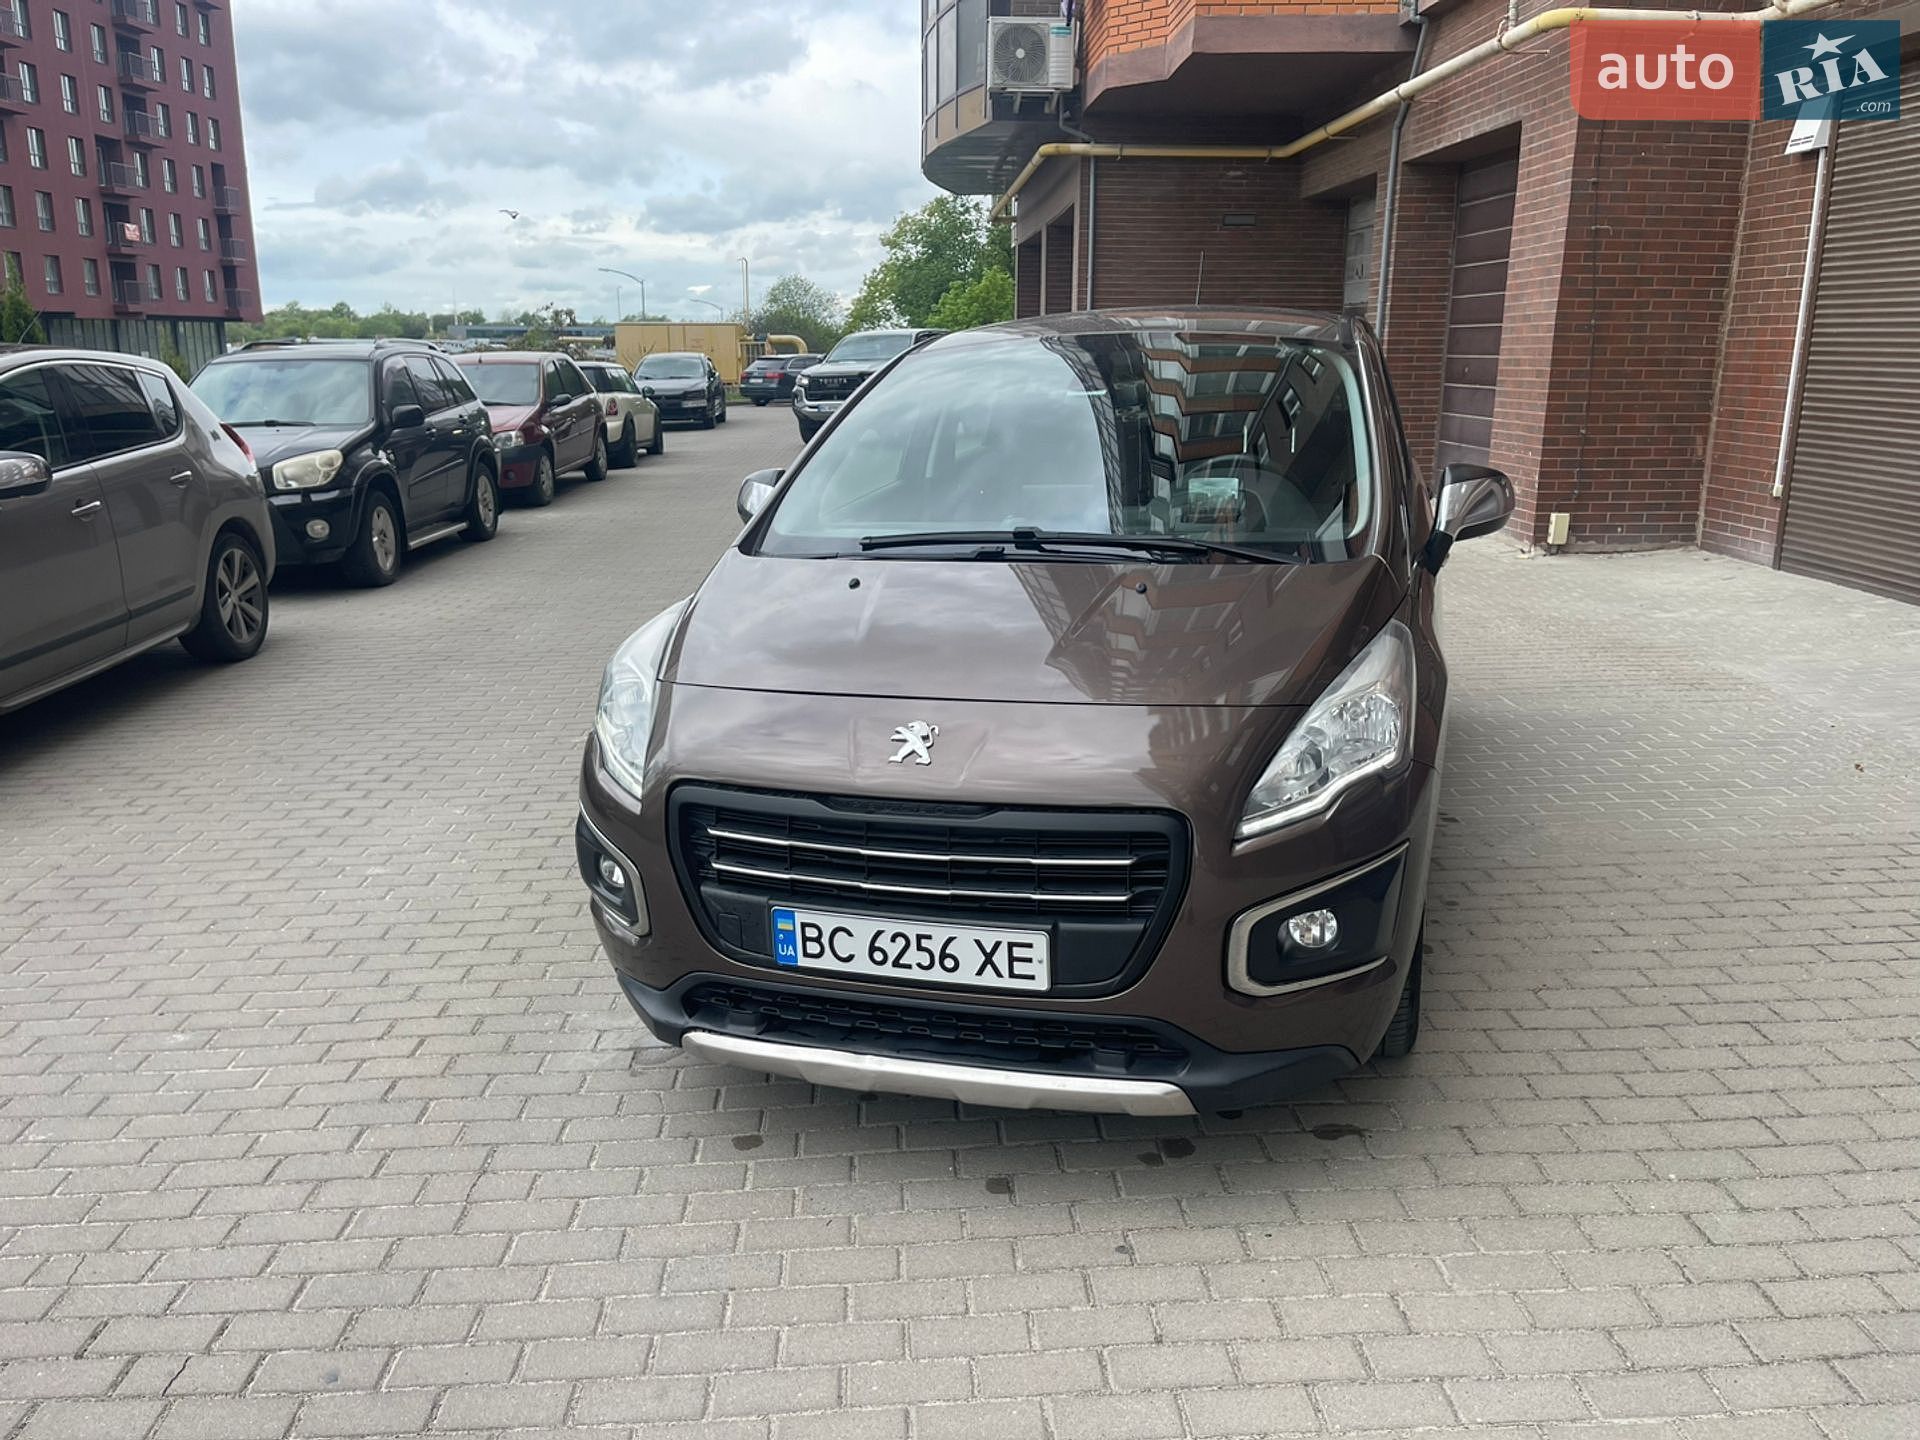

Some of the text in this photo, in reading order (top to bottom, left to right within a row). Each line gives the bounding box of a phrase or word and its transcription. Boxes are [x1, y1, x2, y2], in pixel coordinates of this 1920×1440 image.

[778, 943, 796, 956] UA
[800, 921, 1036, 981] BC 6256 XE
